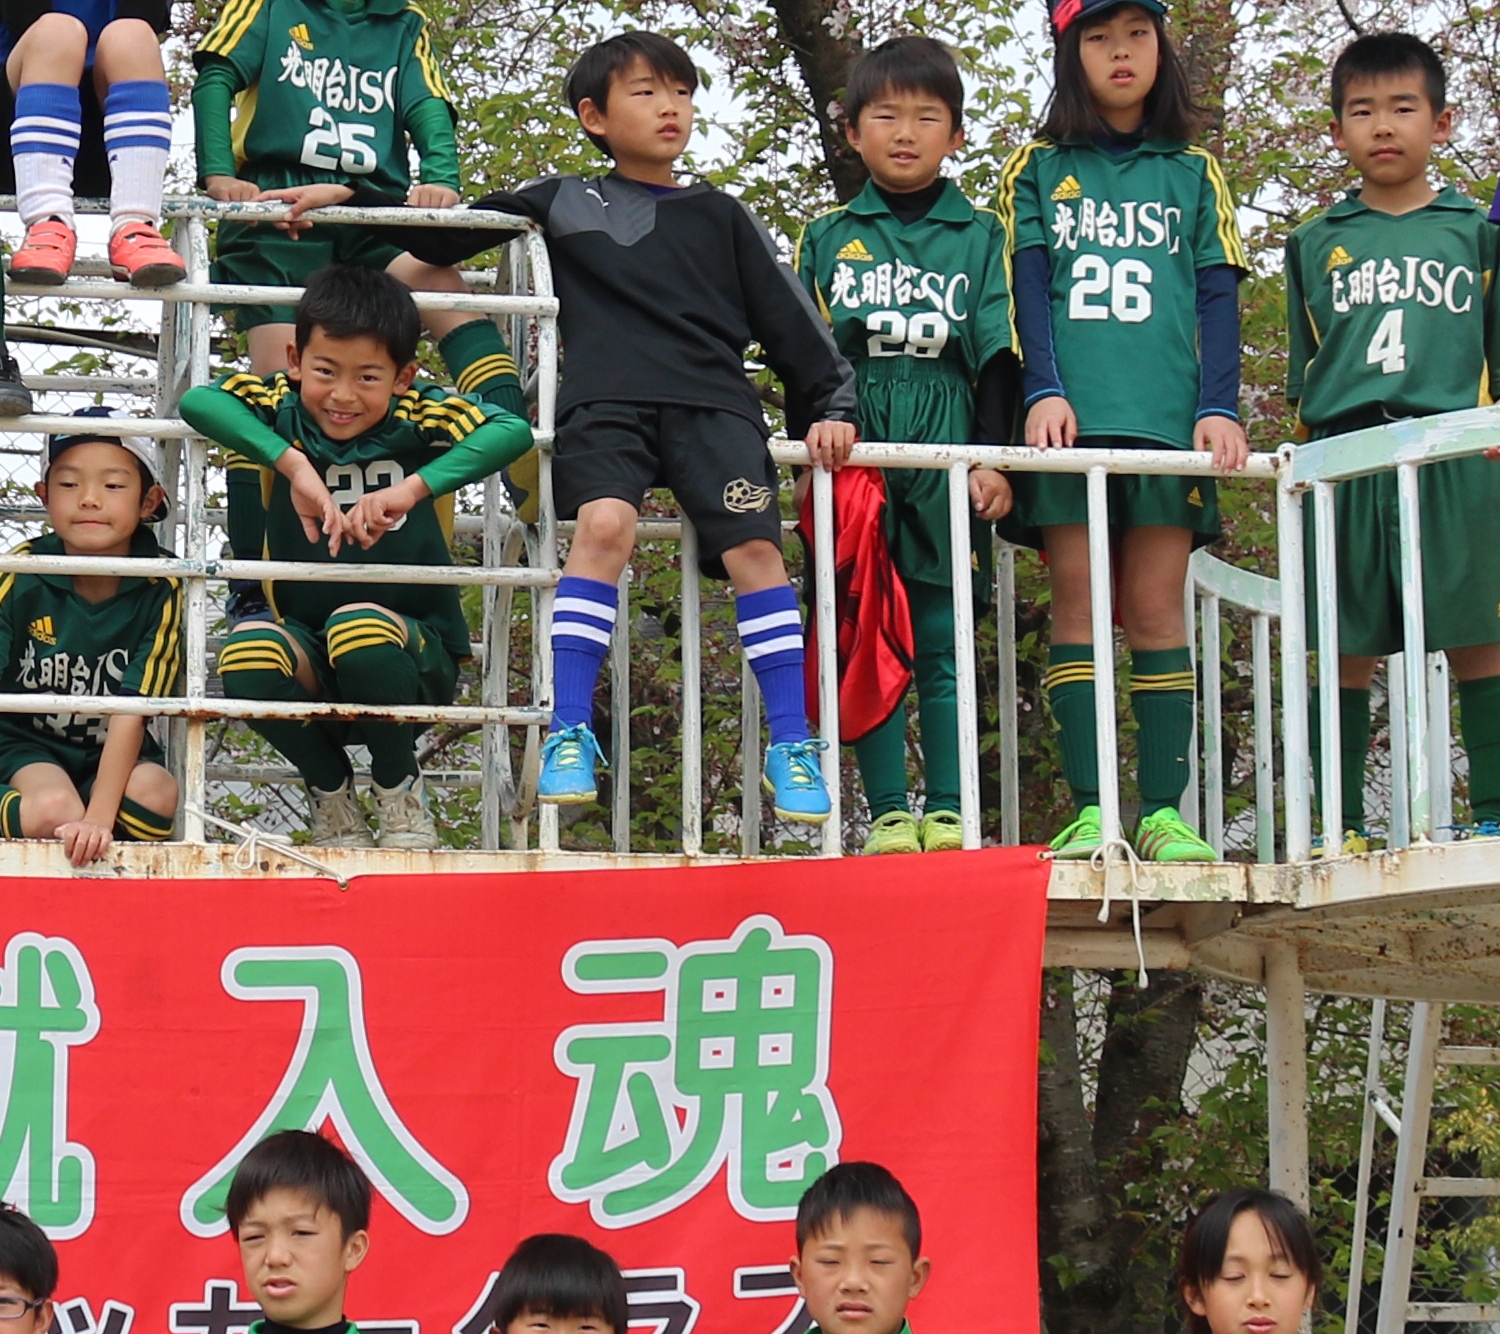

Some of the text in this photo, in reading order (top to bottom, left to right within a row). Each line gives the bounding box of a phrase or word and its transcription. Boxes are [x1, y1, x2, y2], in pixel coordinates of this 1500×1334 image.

[300, 106, 377, 175] 25
[1069, 254, 1153, 323] 26
[1366, 308, 1406, 375] 4
